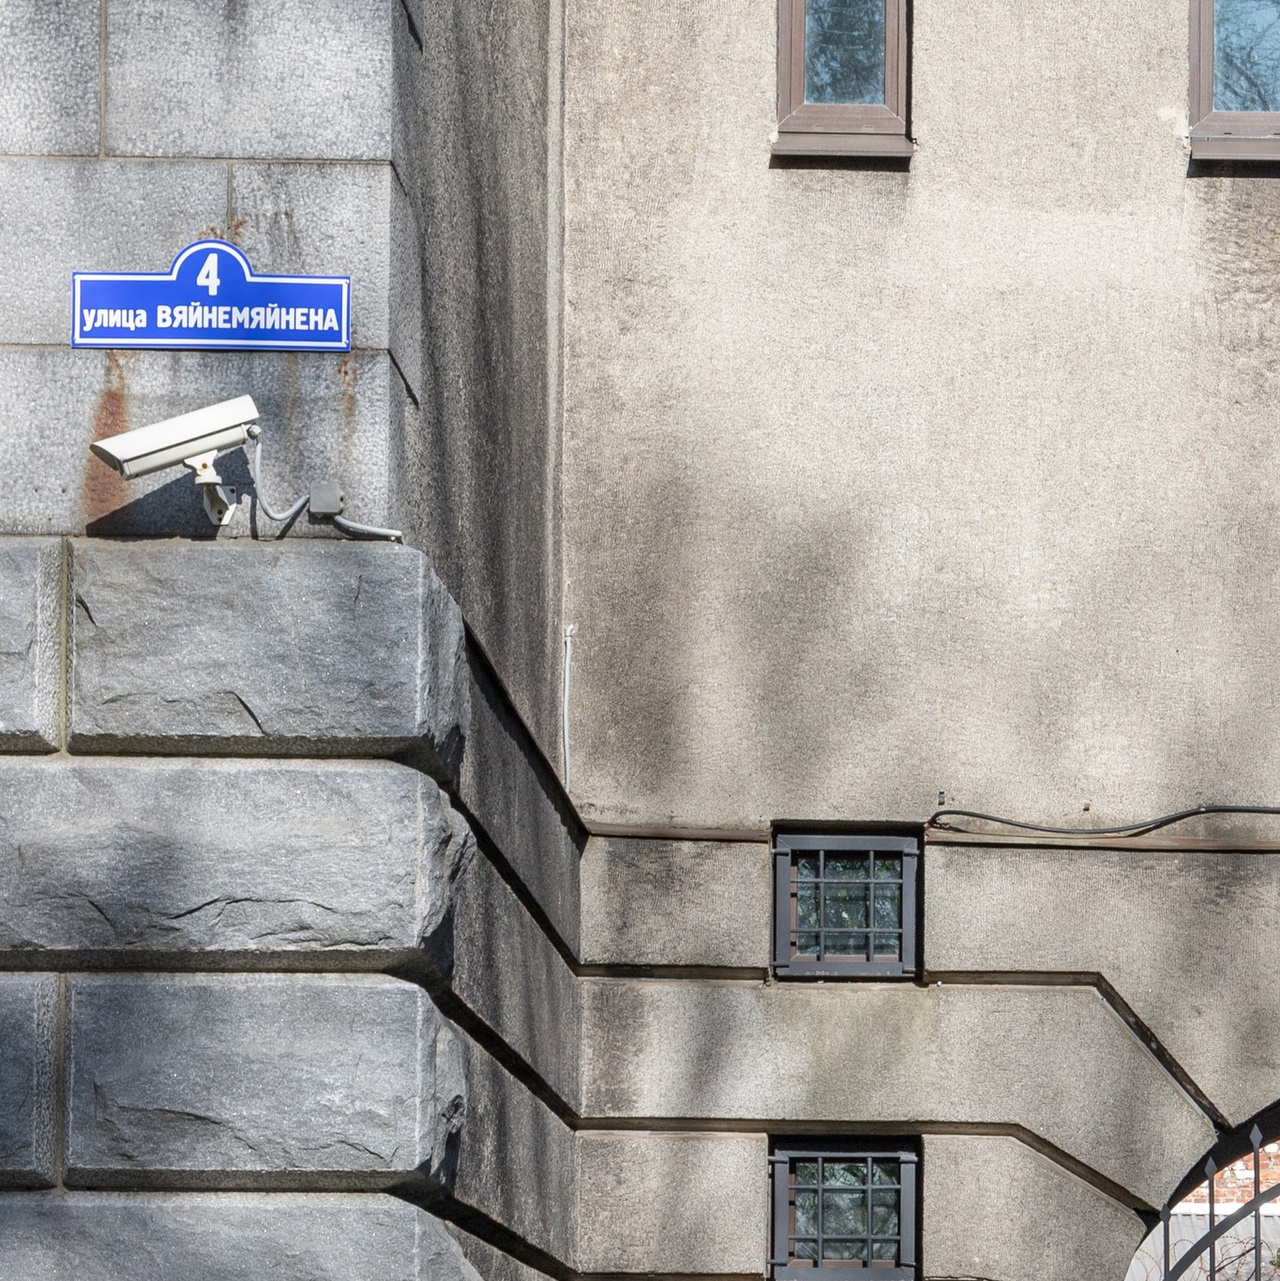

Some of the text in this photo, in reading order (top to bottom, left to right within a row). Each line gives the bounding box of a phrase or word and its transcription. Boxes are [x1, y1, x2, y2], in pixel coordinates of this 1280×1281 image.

[196, 252, 220, 296] 4
[82, 302, 339, 332] улица ВЯЙНЕМЯЙНЕНА
